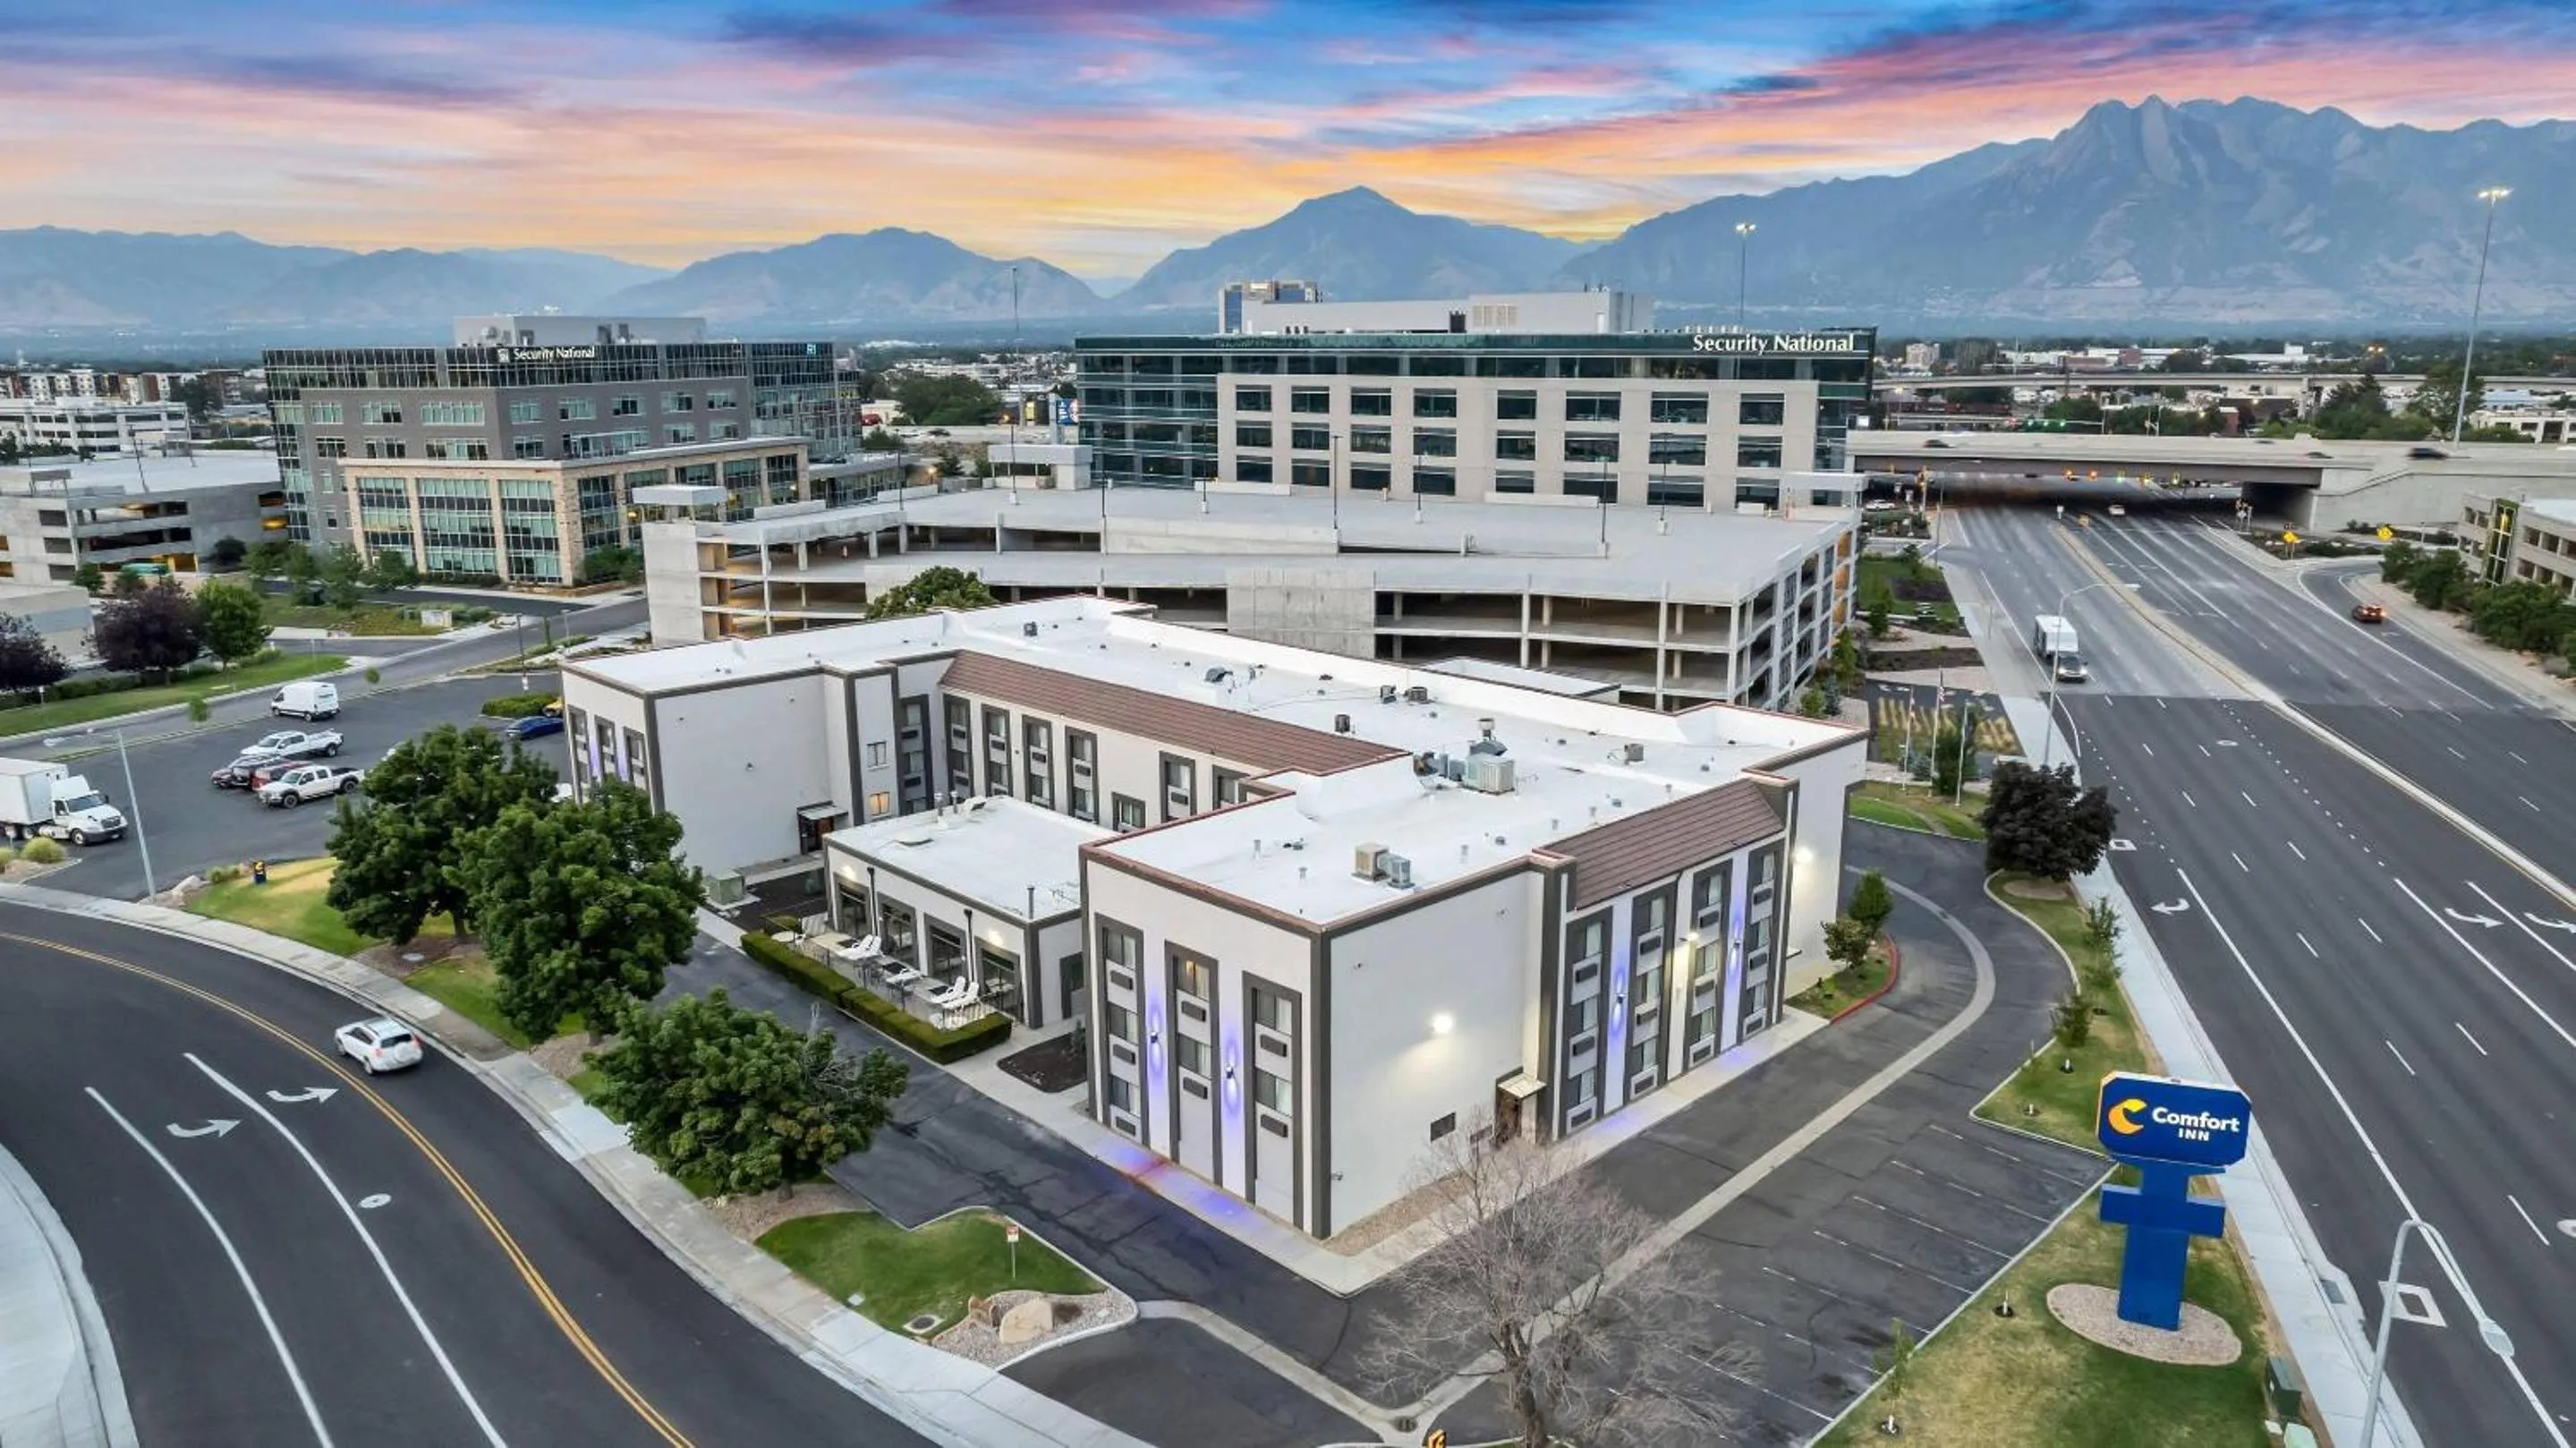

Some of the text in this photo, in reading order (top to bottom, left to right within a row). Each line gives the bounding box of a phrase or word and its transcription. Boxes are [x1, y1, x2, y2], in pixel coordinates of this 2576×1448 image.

[514, 346, 595, 362] Security National
[1694, 334, 1854, 356] Security National
[2152, 1106, 2240, 1132] Comfort
[2178, 1128, 2210, 1142] INN
